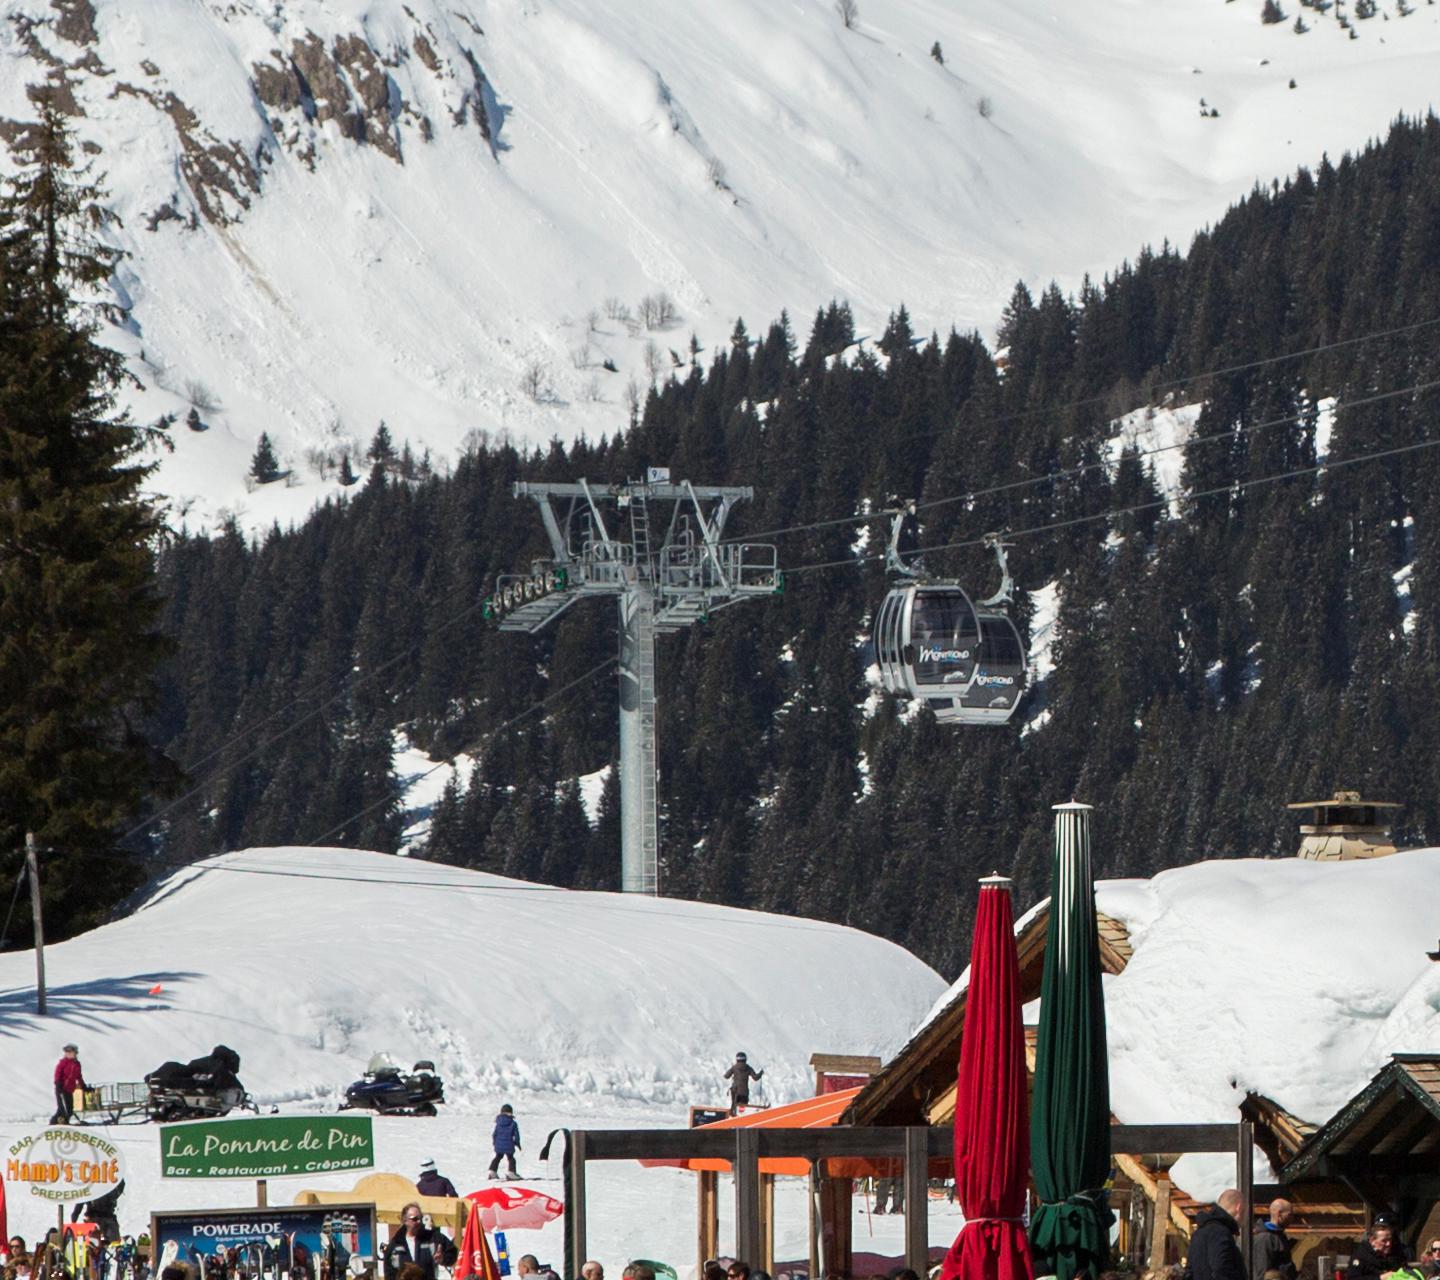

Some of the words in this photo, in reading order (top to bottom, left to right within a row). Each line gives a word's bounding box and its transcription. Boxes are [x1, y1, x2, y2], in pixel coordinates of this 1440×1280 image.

[9, 1136, 33, 1156] BAR
[44, 1130, 117, 1157] BRASSERIE
[166, 1135, 200, 1157] La
[203, 1134, 293, 1157] Pomme
[297, 1129, 323, 1151] de
[327, 1128, 368, 1150] Pin
[6, 1158, 73, 1183] Mamo's
[79, 1158, 118, 1183] Café
[166, 1166, 191, 1176] Bar
[208, 1164, 288, 1176] Restaurant
[305, 1156, 369, 1171] Crêperie
[30, 1186, 91, 1200] CREPERIE
[192, 1222, 284, 1237] POWERADE
